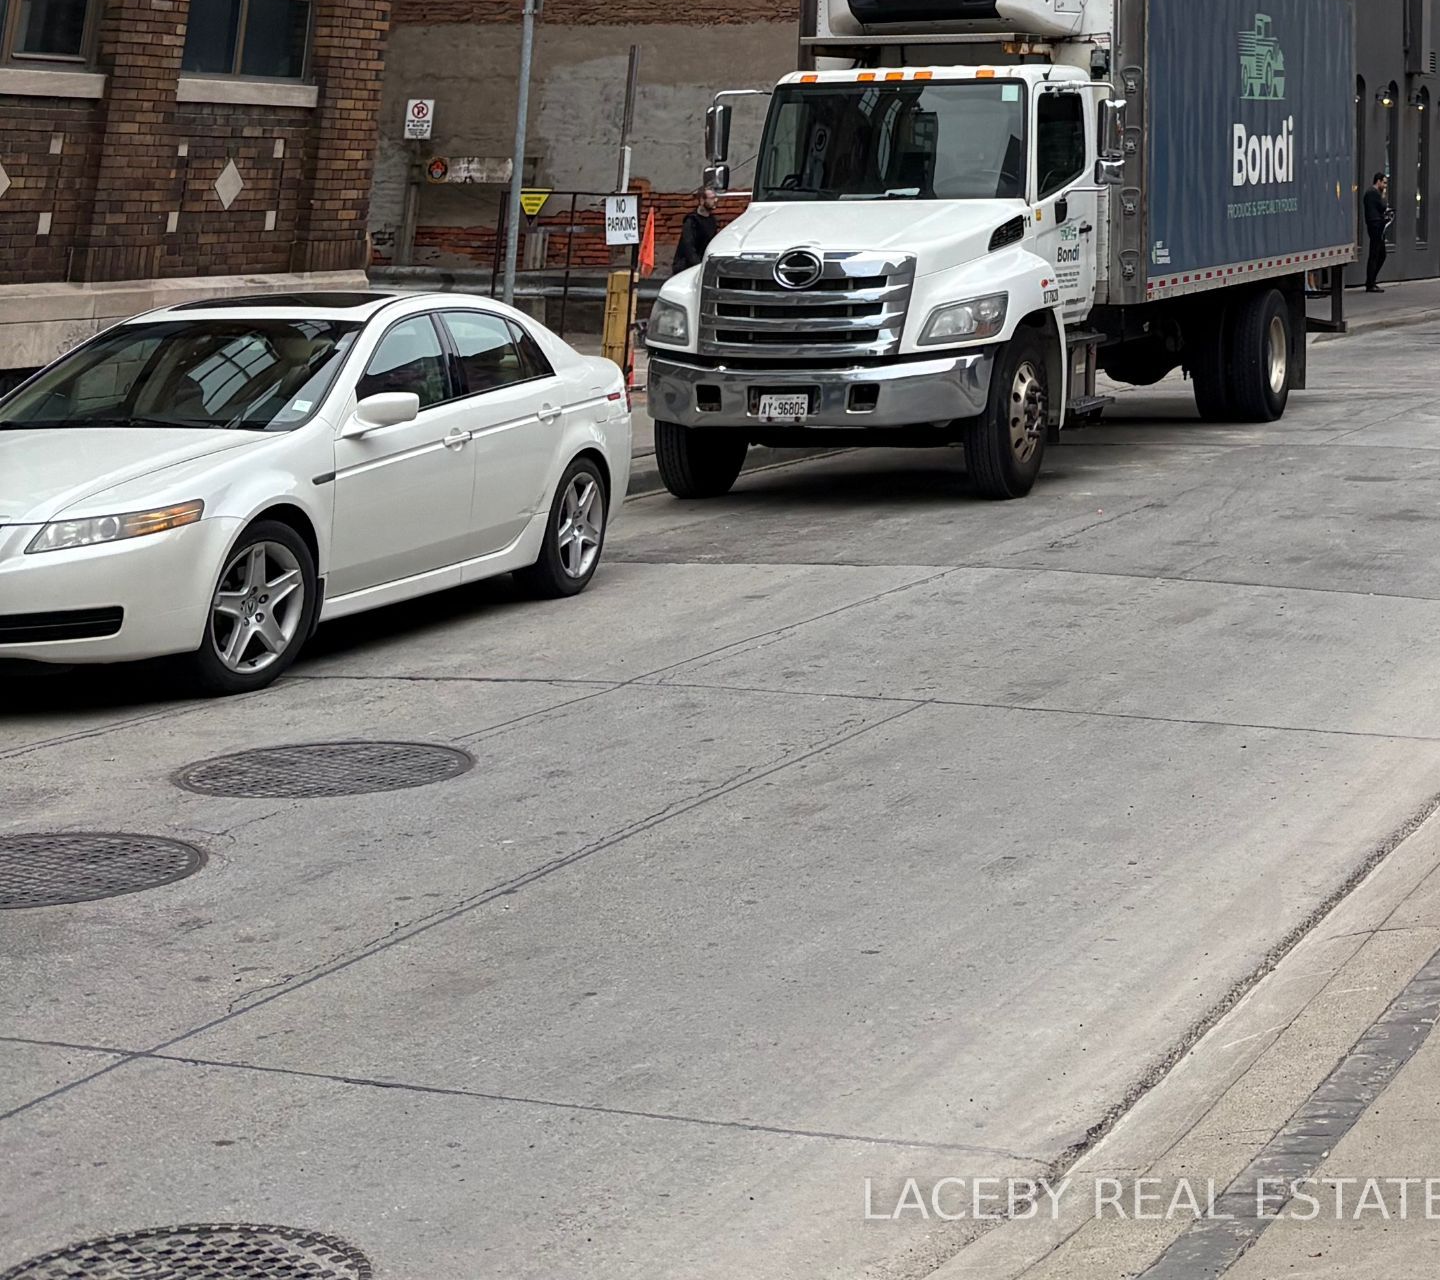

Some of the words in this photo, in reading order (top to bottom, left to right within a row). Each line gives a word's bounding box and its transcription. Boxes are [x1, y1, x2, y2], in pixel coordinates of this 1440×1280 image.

[1232, 115, 1294, 187] Bondi
[615, 199, 626, 214] NO
[1227, 201, 1252, 219] PRODUCE
[607, 216, 637, 232] PARKING
[1057, 244, 1080, 263] Bondi
[777, 401, 806, 416] 96805
